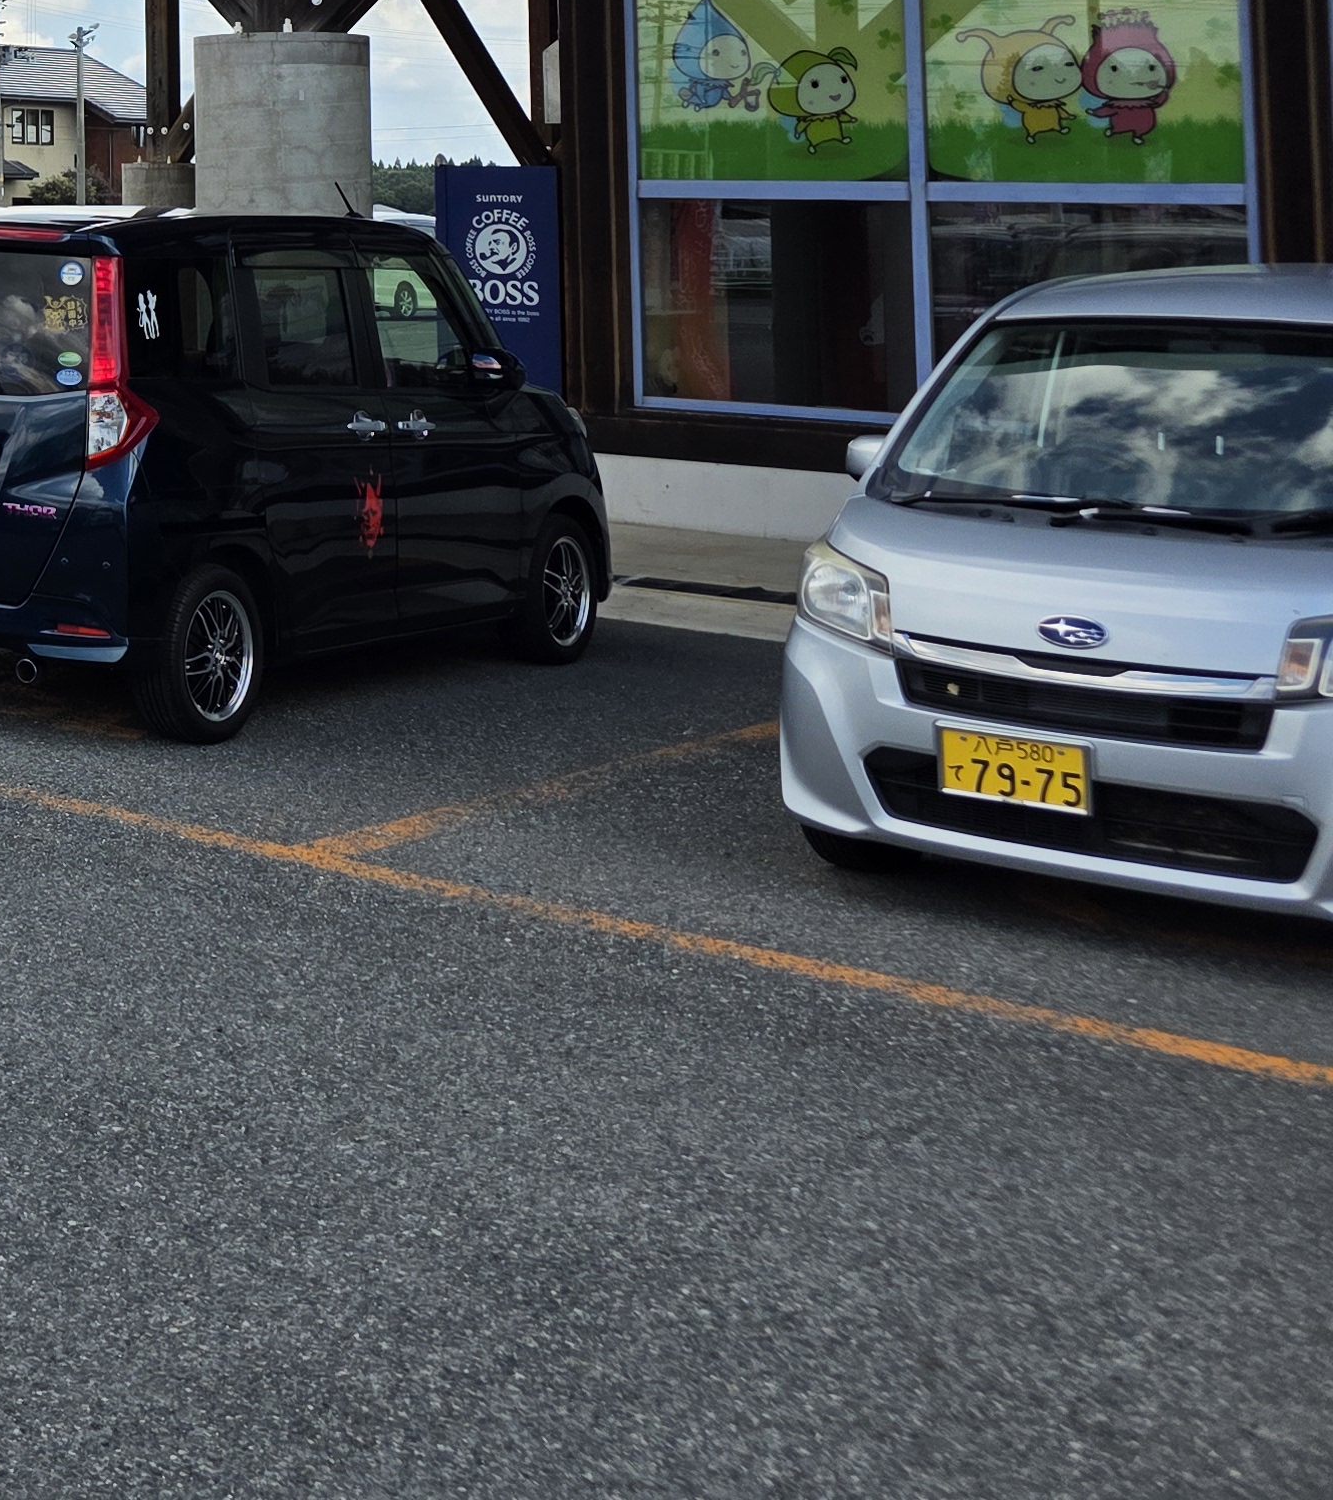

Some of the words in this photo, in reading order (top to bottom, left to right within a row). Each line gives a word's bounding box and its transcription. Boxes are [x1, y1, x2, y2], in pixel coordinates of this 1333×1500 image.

[475, 194, 523, 203] SUNTORY
[472, 209, 529, 230] COFFEE
[465, 229, 477, 258] COFFEE
[524, 230, 537, 251] BOSS
[468, 259, 487, 278] BOSS
[515, 253, 536, 279] COFFEE
[973, 735, 1055, 763] 八戸580
[947, 764, 964, 781] て
[971, 757, 1081, 807] 79-75
